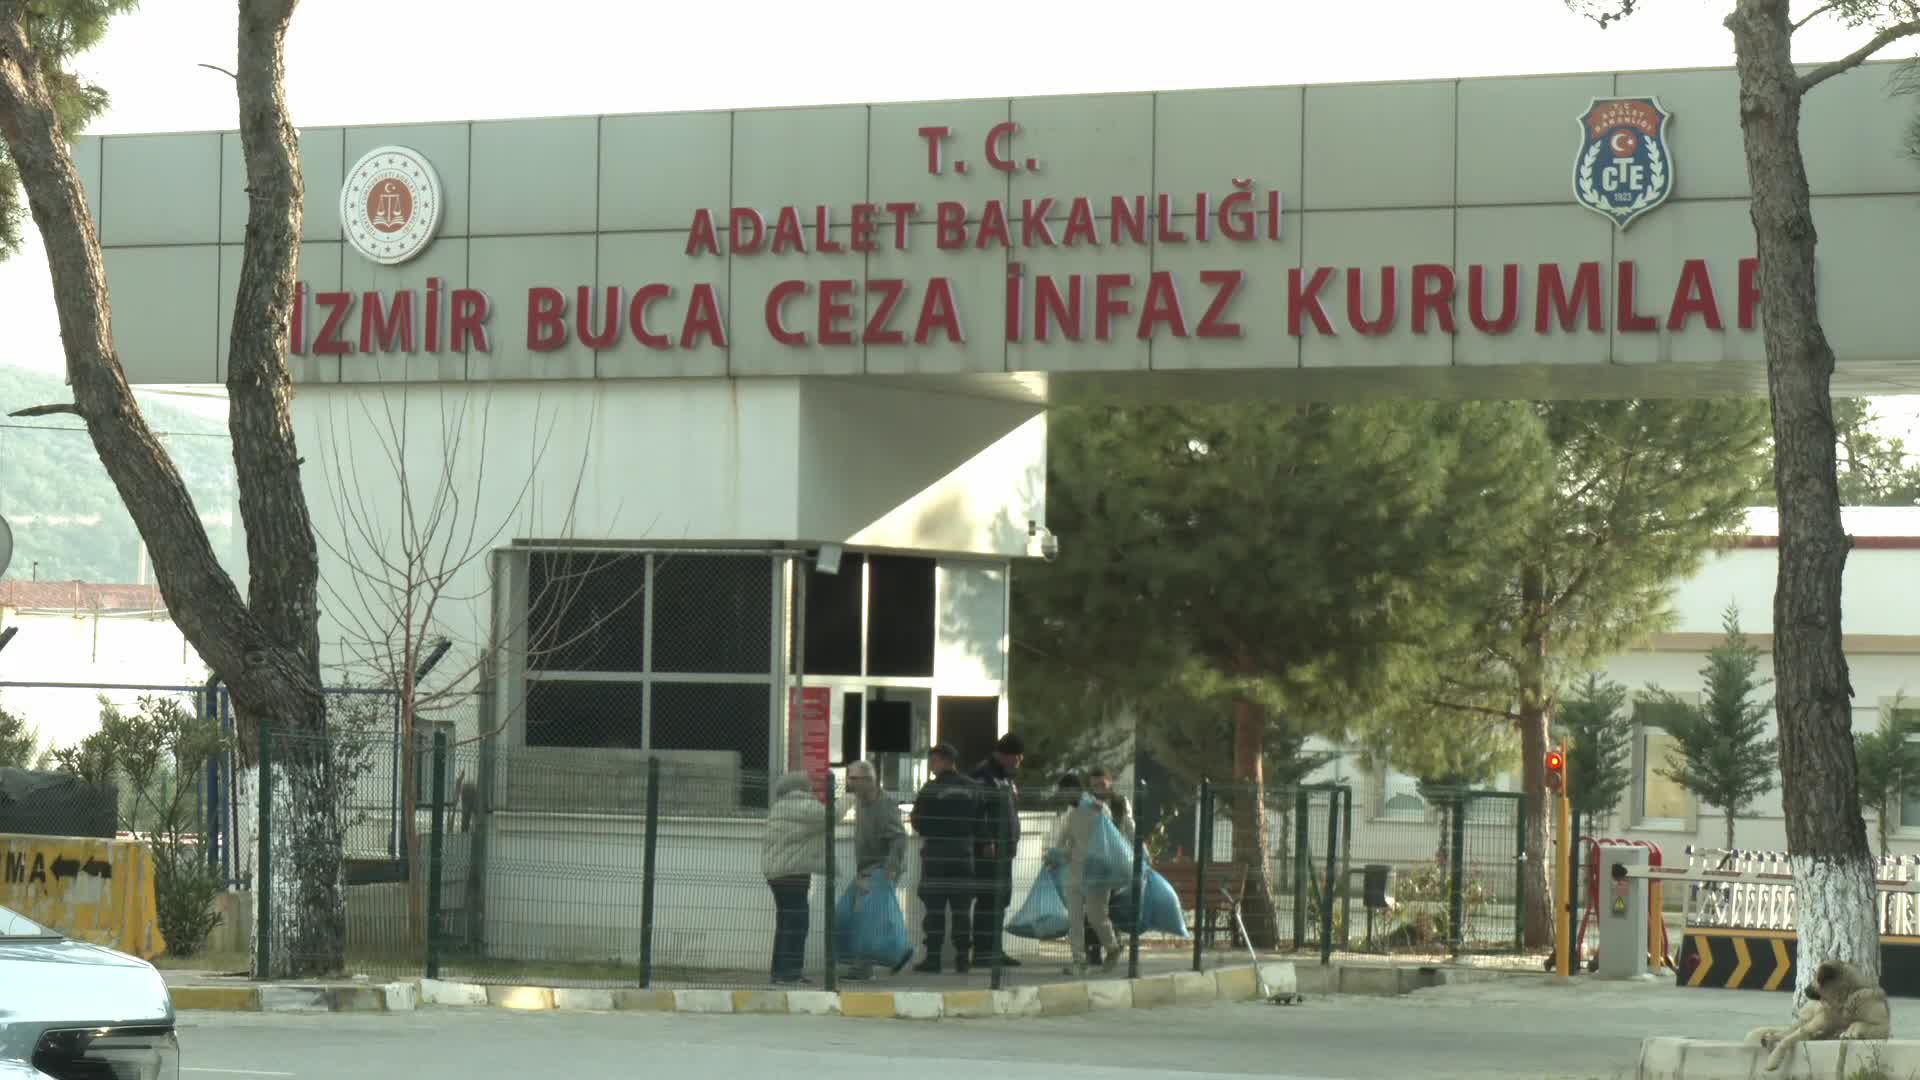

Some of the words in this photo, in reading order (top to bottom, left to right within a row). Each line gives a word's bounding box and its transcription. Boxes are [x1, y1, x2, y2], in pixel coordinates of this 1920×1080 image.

[1602, 157, 1643, 191] CTE
[686, 203, 916, 254] ADALET
[936, 177, 1281, 249] BAKANLIĞI
[290, 278, 490, 353] İZMİR
[527, 283, 726, 351] BUCA
[766, 278, 965, 346] CEZA
[1007, 263, 1244, 342] İNFAZ
